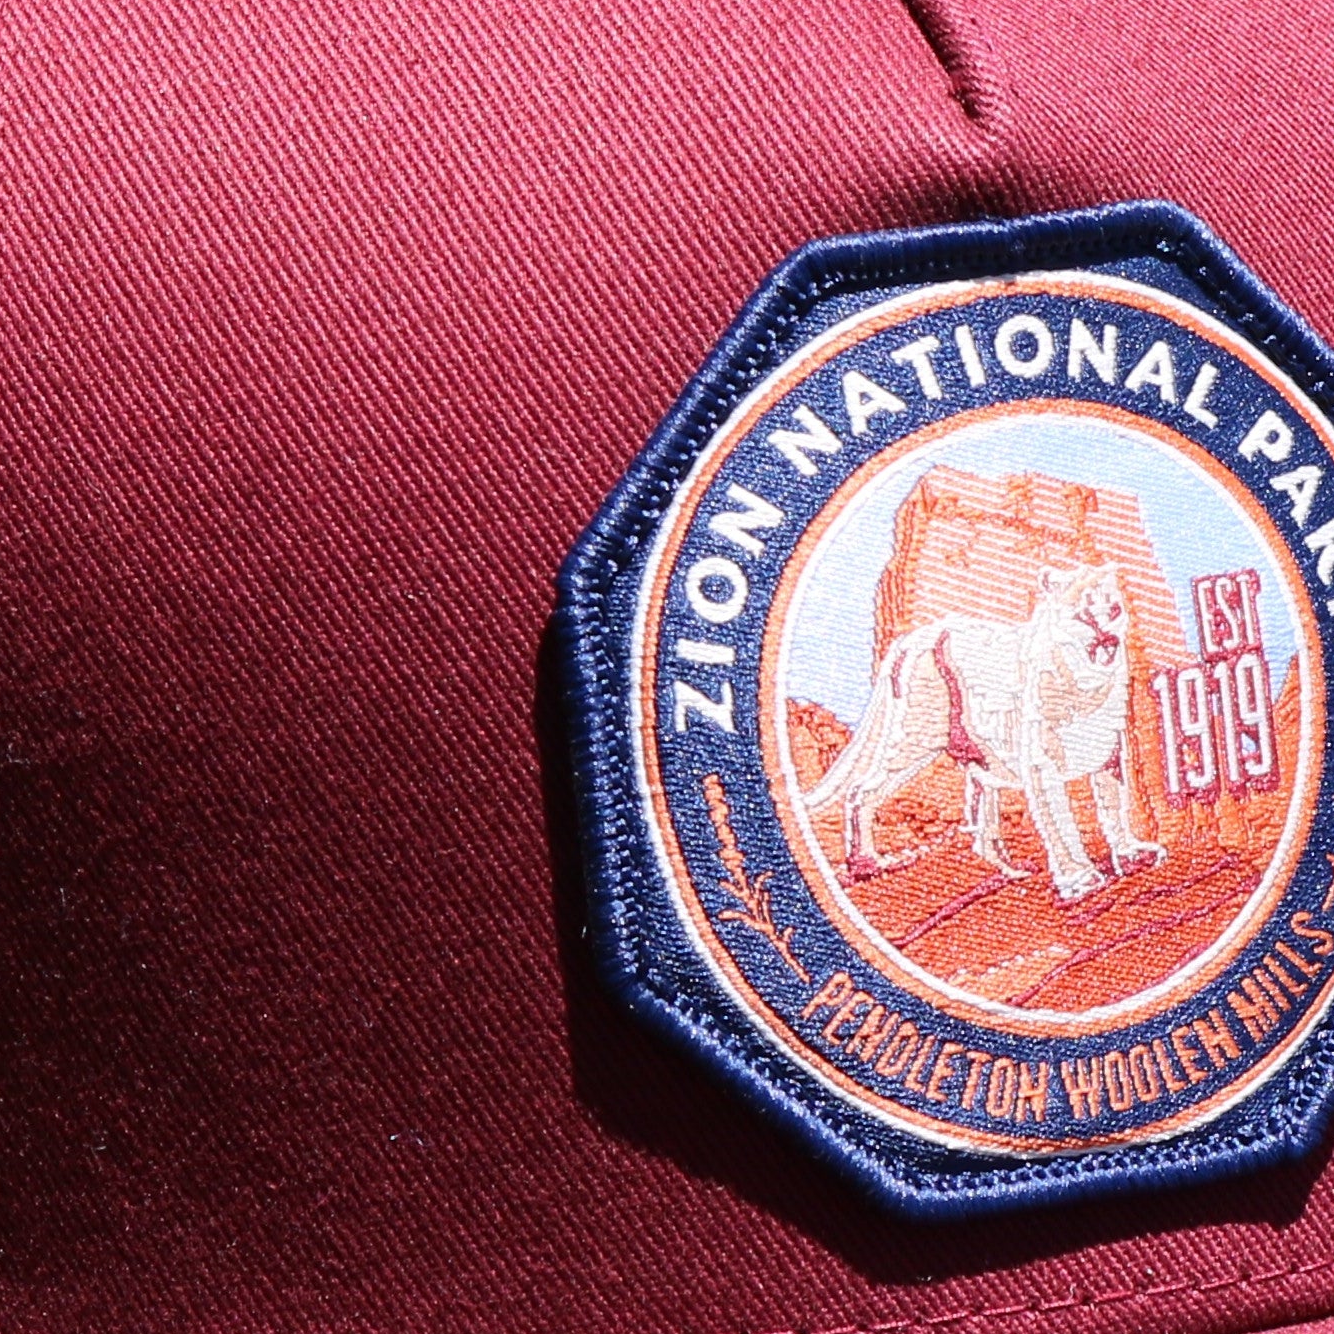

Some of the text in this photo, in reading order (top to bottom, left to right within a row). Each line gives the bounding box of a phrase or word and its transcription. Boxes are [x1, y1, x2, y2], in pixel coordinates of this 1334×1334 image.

[674, 482, 785, 734] ZION
[769, 313, 1219, 477] NATIONAL
[1197, 575, 1260, 655] EST
[1154, 662, 1270, 796] 1919
[803, 970, 1046, 1124] PENDLETON
[1063, 1010, 1238, 1119] WOOLEN
